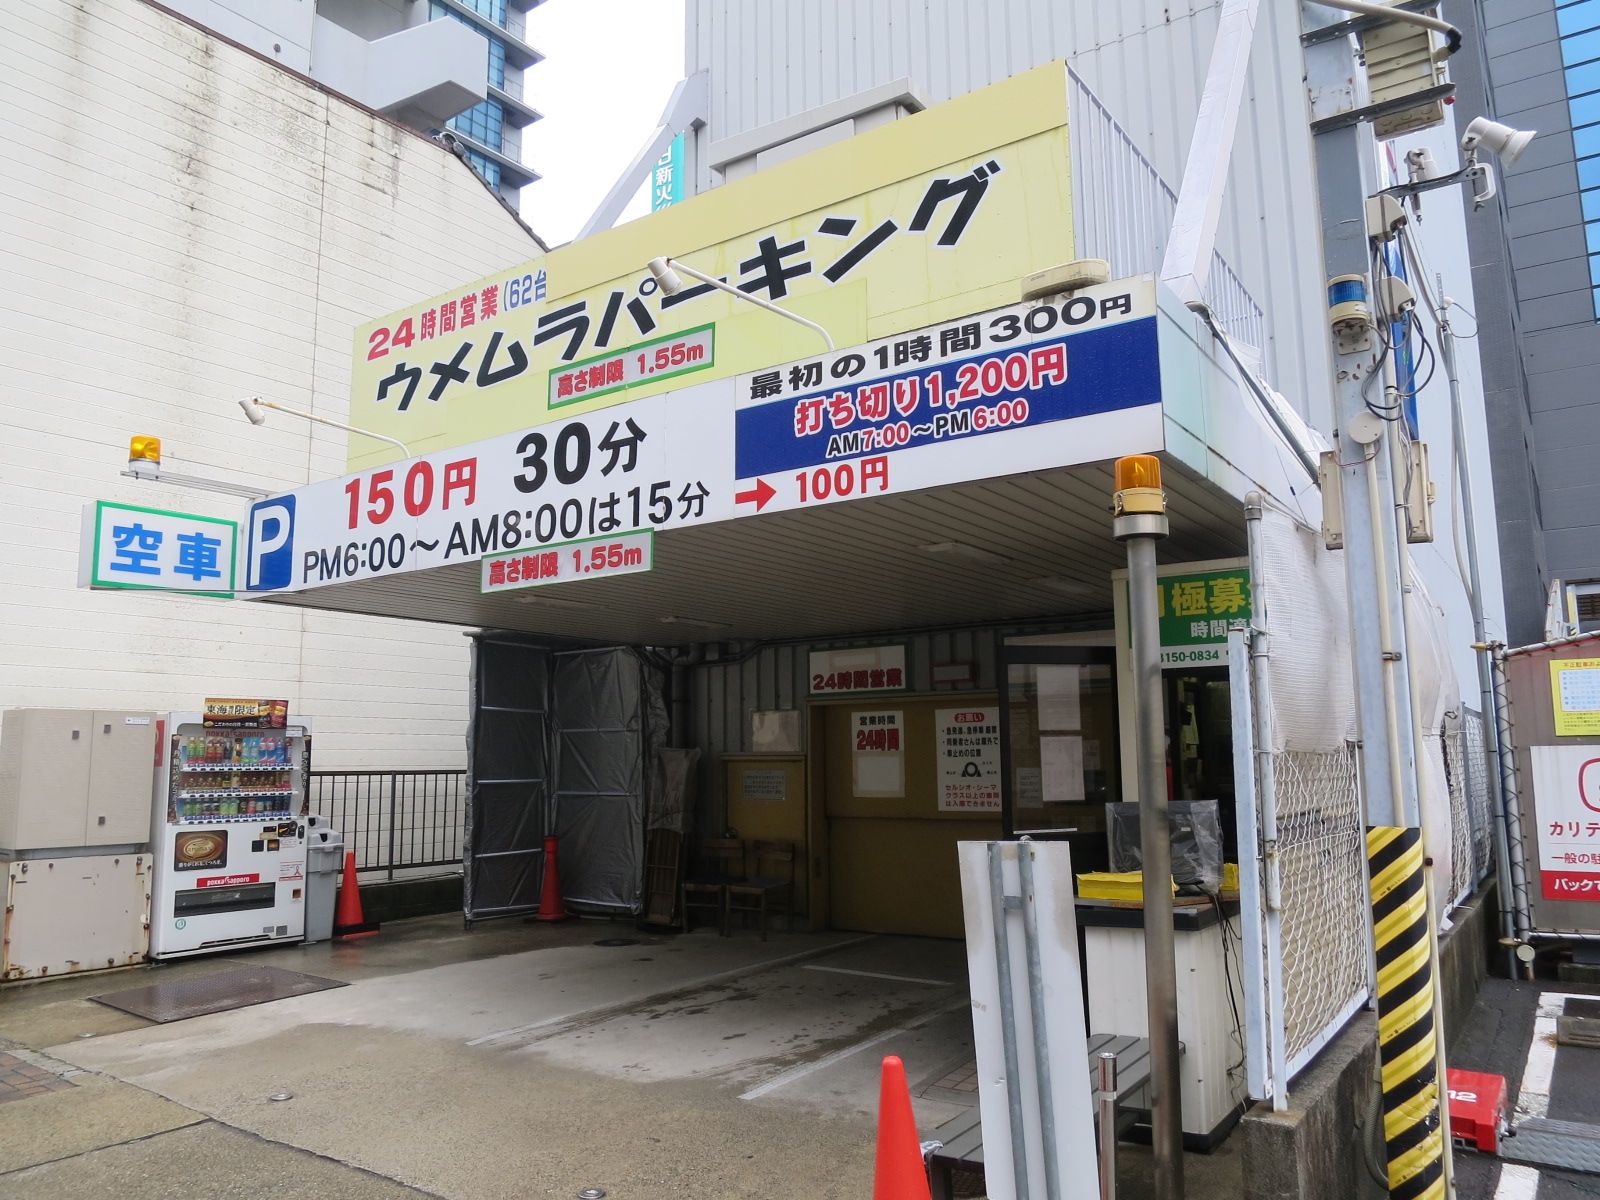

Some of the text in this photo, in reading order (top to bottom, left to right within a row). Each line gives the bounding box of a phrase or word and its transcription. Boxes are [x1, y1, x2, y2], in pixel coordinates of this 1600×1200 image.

[377, 159, 1001, 411] ウメムラパーキング
[367, 285, 498, 361] 24時間営業
[750, 293, 1132, 400] 最初の1時間300円
[557, 342, 705, 399] 高さ制限 1.55m
[795, 344, 1066, 436] 打ち切り1,200円
[345, 417, 647, 530] 150円 30分
[796, 456, 889, 503] 100円
[110, 523, 221, 582] 空車
[250, 505, 291, 588] P
[488, 543, 642, 586] 高さ制限 1.55m
[1158, 577, 1253, 618] 極募
[813, 668, 902, 691] 24時間営業
[857, 728, 900, 751] 24時間
[859, 715, 896, 726] 営業時間
